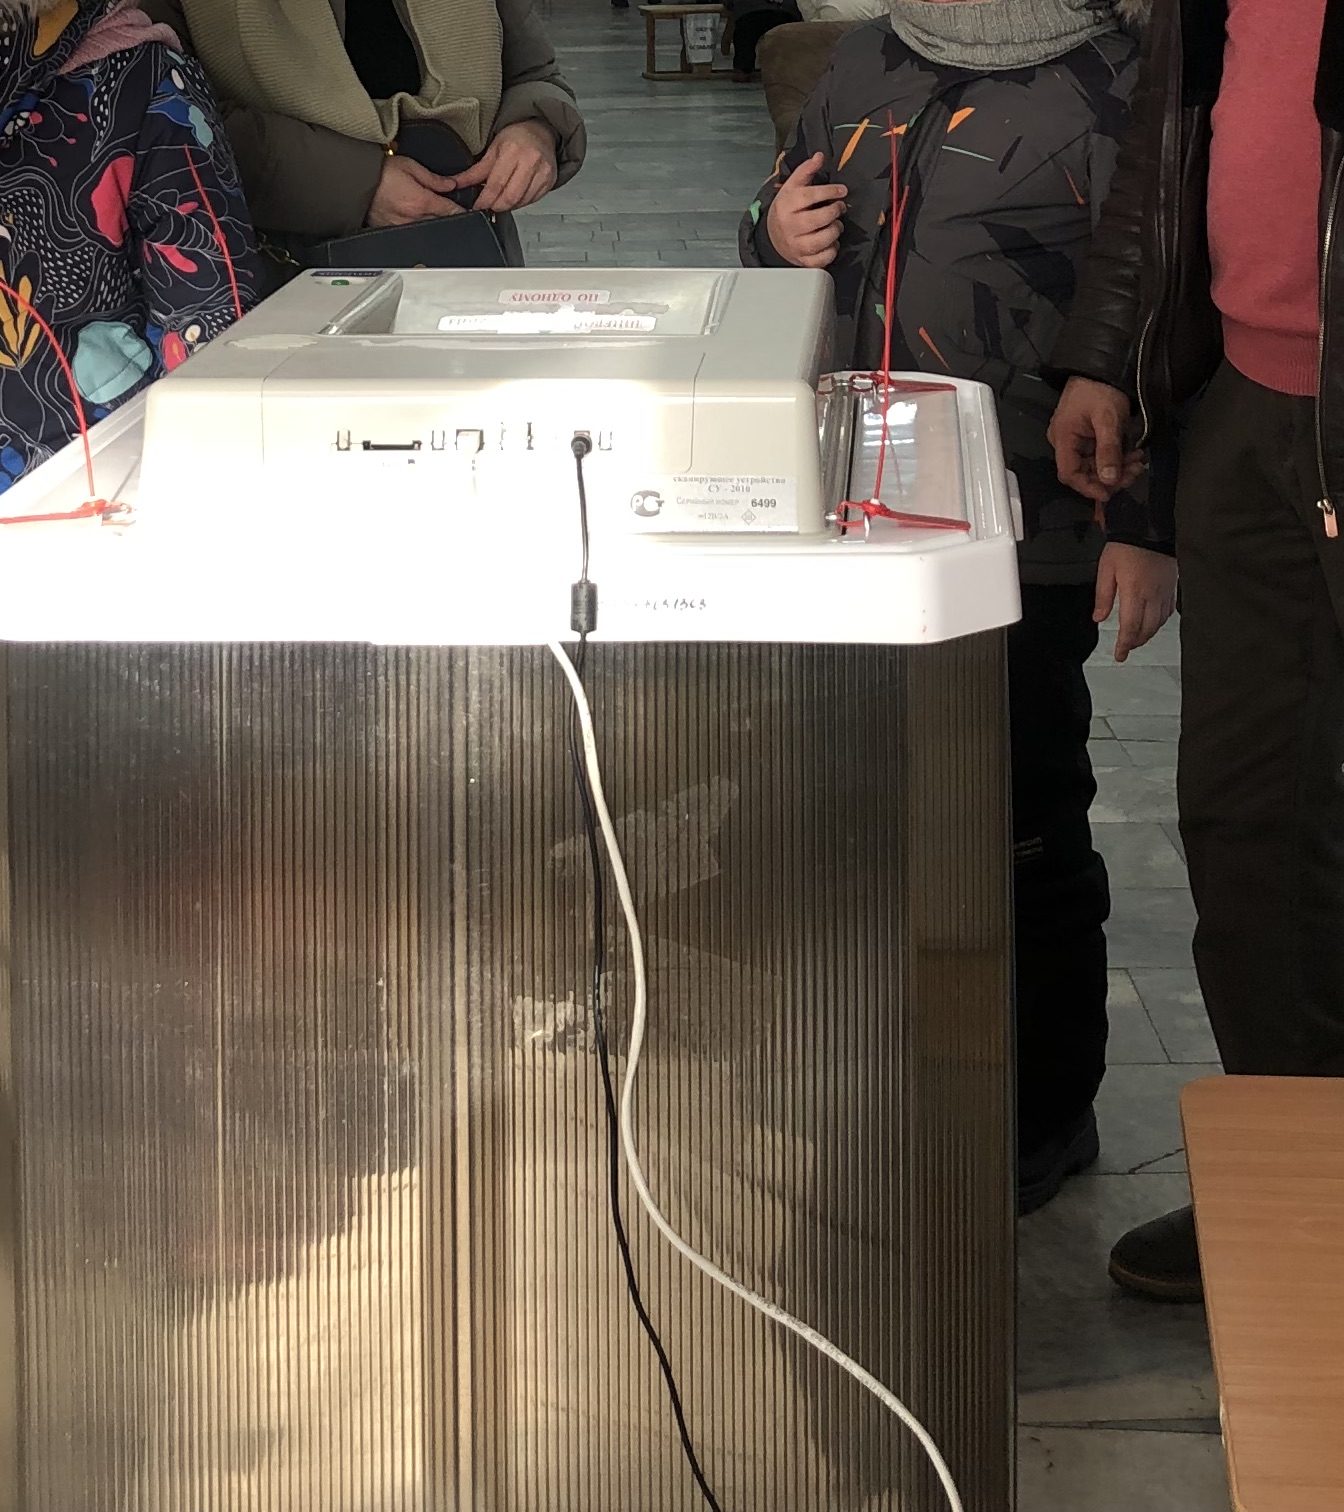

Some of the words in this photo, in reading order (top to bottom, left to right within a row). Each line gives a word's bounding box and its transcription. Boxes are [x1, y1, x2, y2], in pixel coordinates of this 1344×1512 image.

[509, 292, 572, 303] ОДНОМУ
[577, 293, 600, 303] ПО
[751, 498, 777, 508] 6499
